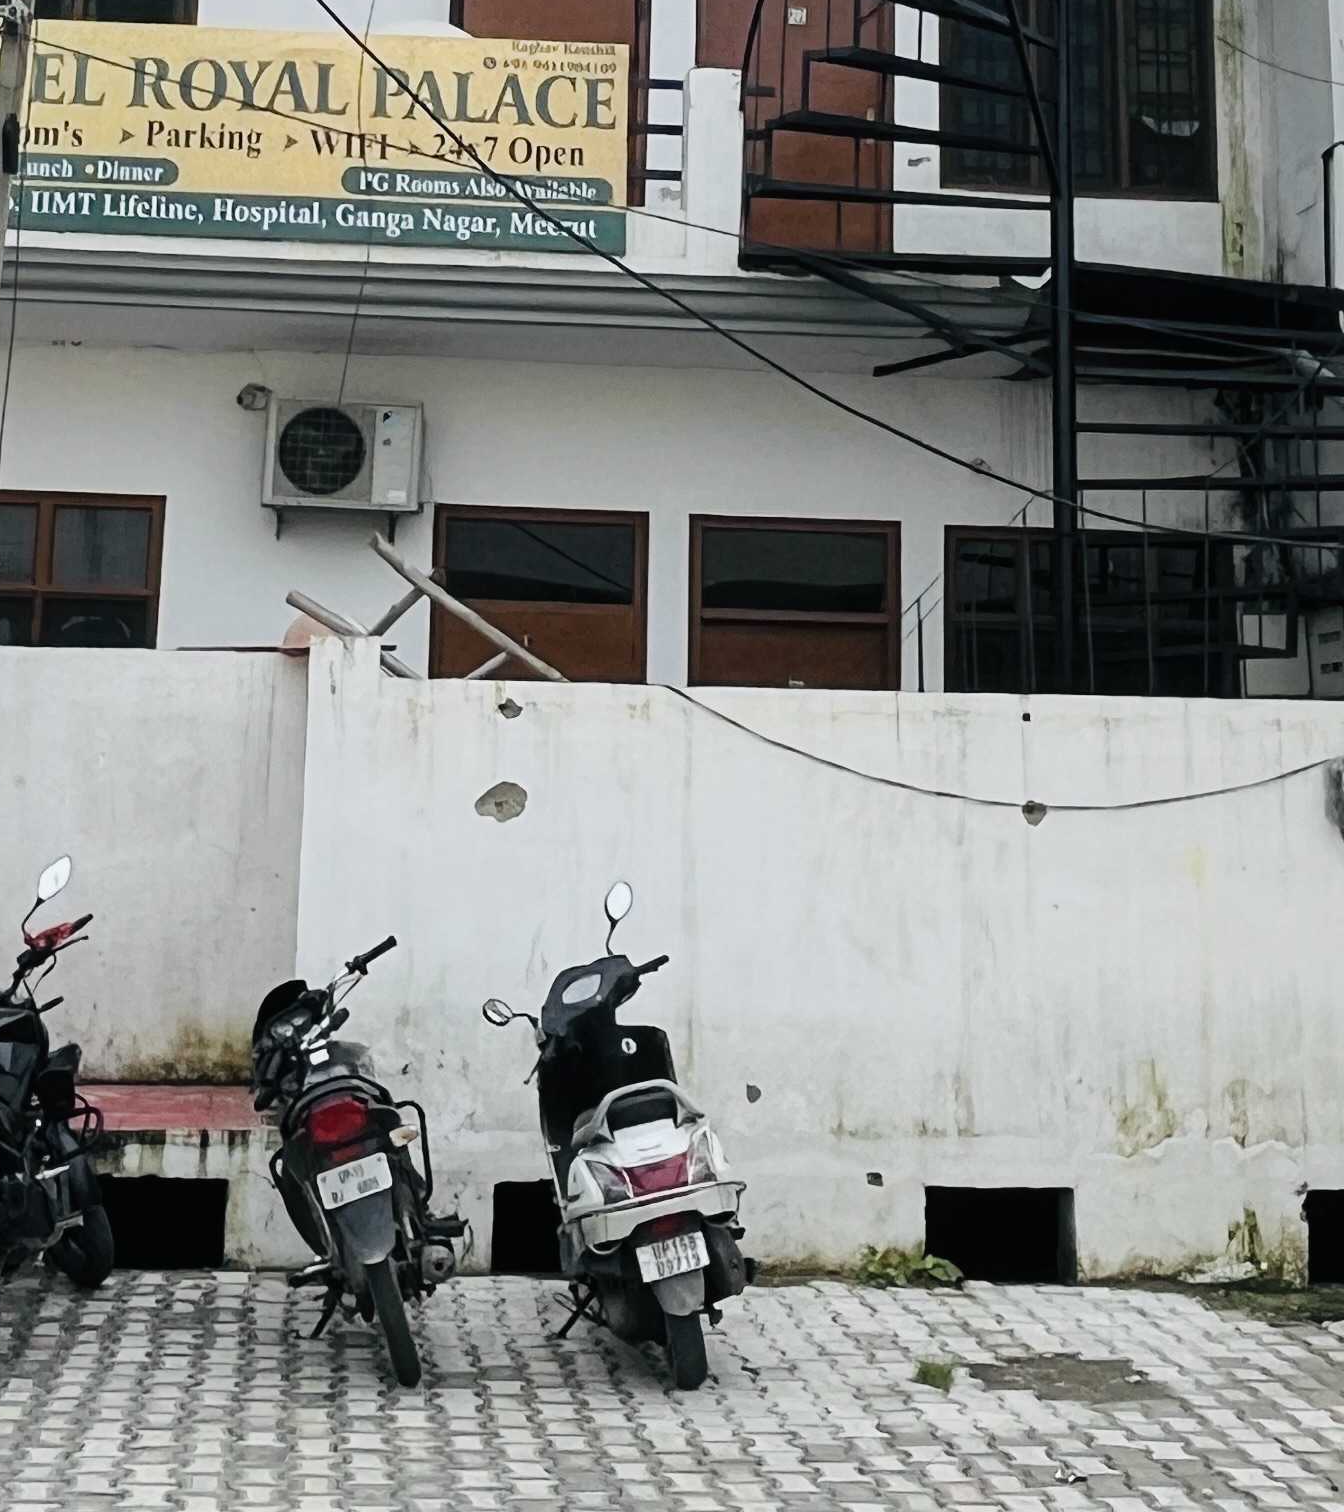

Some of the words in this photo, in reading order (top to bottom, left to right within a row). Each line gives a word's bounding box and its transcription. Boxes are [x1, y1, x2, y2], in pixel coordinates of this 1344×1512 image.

[126, 56, 351, 116] ROYAL
[369, 66, 617, 130] PALACE
[26, 159, 73, 178] unch
[97, 160, 165, 183] Dinner
[146, 119, 263, 159] Parking
[310, 128, 388, 161] WIFI
[508, 136, 585, 172] Open
[359, 169, 389, 192] PG
[395, 173, 459, 195] Rooms
[465, 177, 506, 198] Also
[31, 190, 96, 216] IIMT
[102, 192, 205, 224] Lifeline,
[212, 197, 327, 231] Hospital,
[335, 203, 414, 238] Ganga
[422, 207, 501, 241] Nagar,
